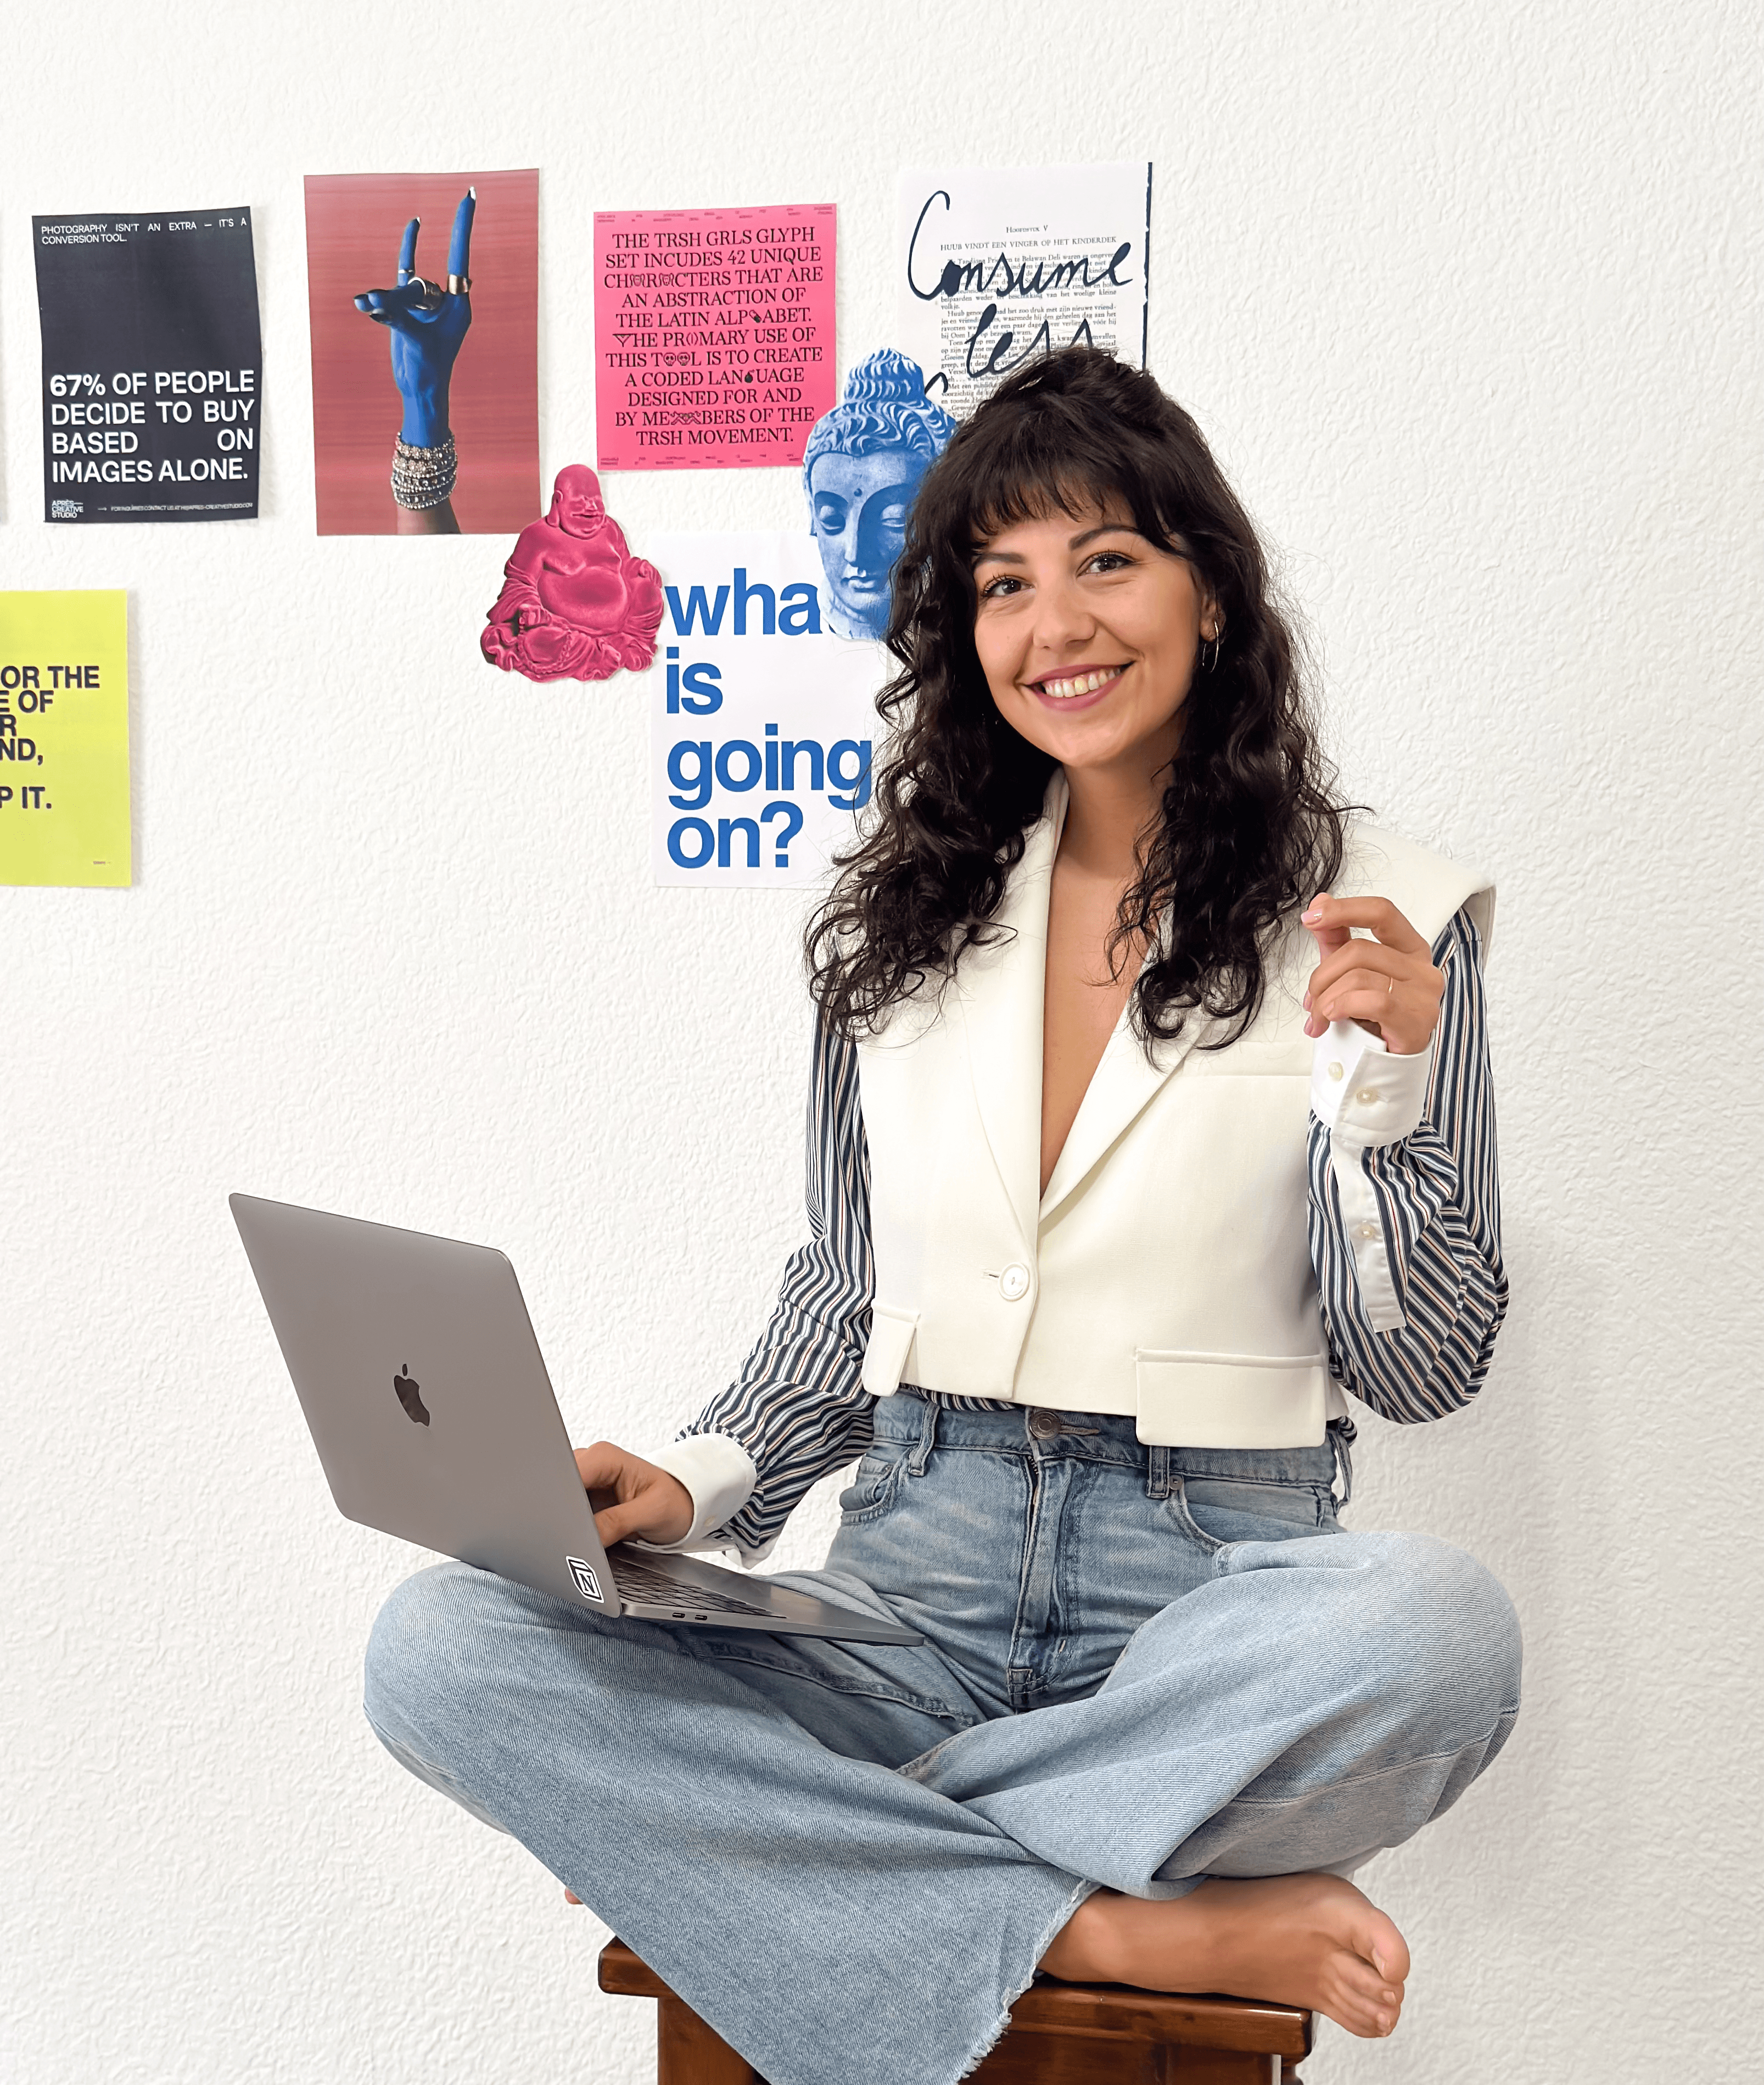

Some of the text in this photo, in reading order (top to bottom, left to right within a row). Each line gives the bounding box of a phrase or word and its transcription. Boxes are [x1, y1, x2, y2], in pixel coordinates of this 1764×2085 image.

[42, 224, 107, 234] PHOTOGRAPHY
[116, 223, 139, 232] ISN'T
[148, 223, 160, 231] AN
[169, 222, 197, 231] EXTRA
[219, 219, 234, 228] IT'S
[241, 217, 247, 226] A
[42, 233, 127, 244] CONVERSION TOOL.
[612, 227, 814, 248] THE TRSH GRLS GLYPH
[606, 247, 821, 268] SET INCUDES 42 UNIQUE
[735, 268, 782, 284] THAT
[787, 267, 823, 282] ARE
[622, 288, 805, 308] AN ABSTRACTION OF
[616, 313, 653, 327] THE
[658, 312, 710, 327] LATIN
[754, 328, 787, 343] USE
[792, 327, 816, 342] OF
[606, 353, 647, 367] THIS
[707, 351, 721, 365] IS
[725, 350, 749, 364] TO
[754, 347, 822, 363] CREATE
[51, 370, 254, 396] 67% OF PEOPLE
[625, 373, 637, 387] A
[642, 371, 703, 387] CODED
[629, 388, 802, 406] DESIGNED FOR AND
[52, 399, 254, 424] DECIDE TO BUY
[615, 412, 637, 426] BY
[750, 408, 773, 423] OF
[778, 407, 814, 422] THE
[53, 428, 253, 454] BASED ON
[636, 427, 793, 445] TRSH MOVEMENT.
[53, 458, 248, 482] IMAGES ALONE.
[665, 568, 837, 635] wha
[48, 666, 99, 688] THE
[667, 647, 723, 715] is
[18, 690, 54, 713] OF
[668, 724, 872, 811] going
[22, 787, 51, 808] IT.
[667, 801, 804, 869] on?
[579, 1573, 595, 1594] N
